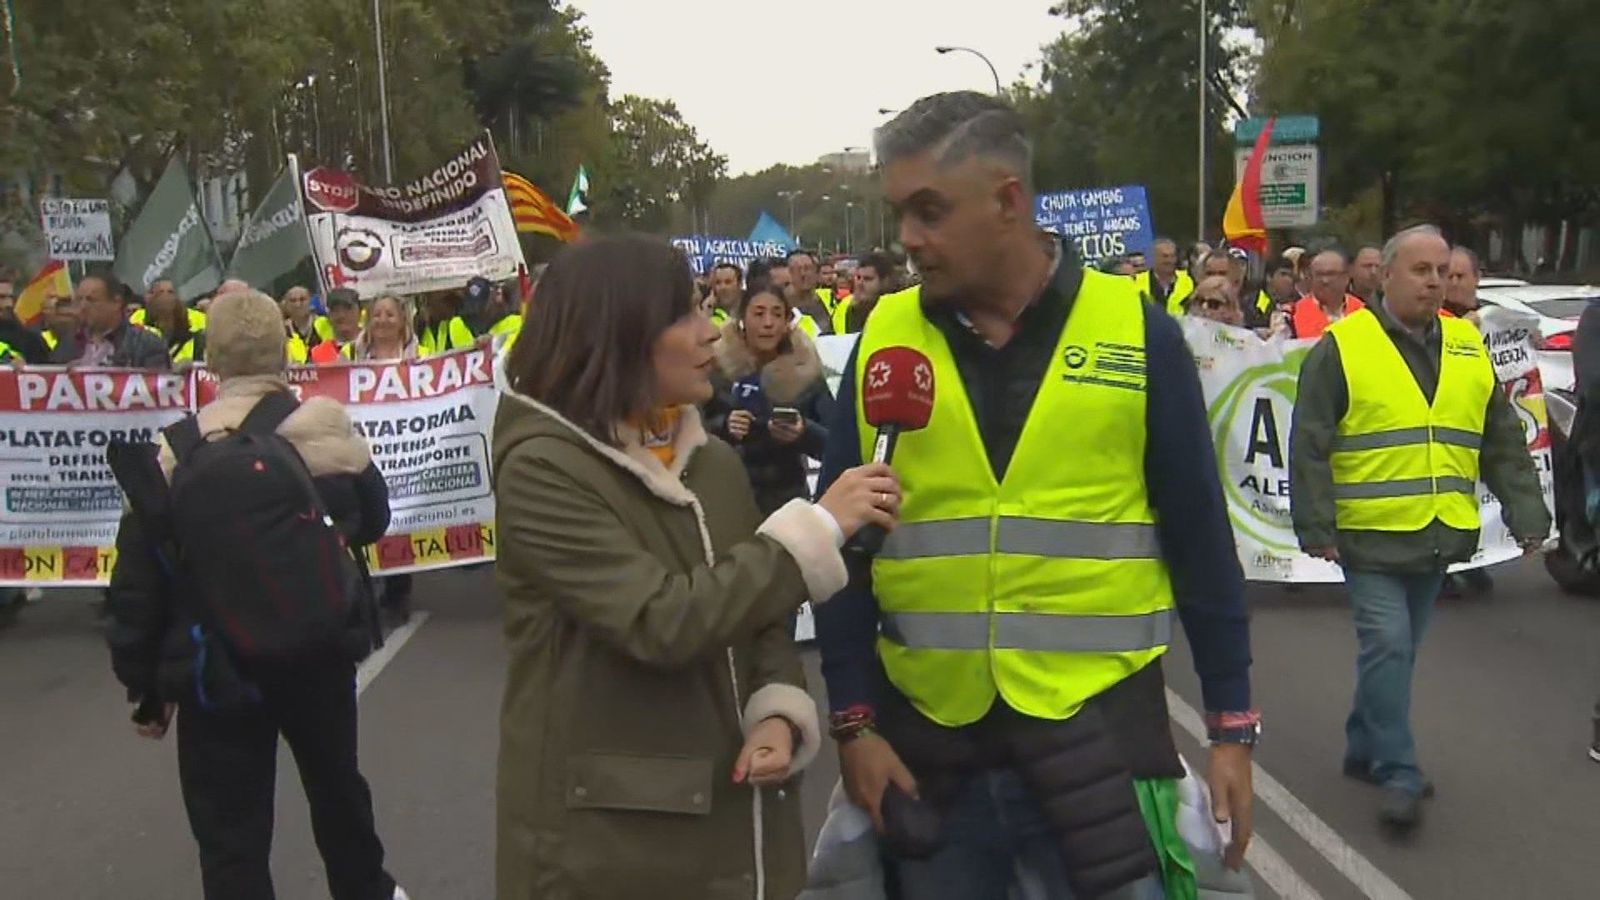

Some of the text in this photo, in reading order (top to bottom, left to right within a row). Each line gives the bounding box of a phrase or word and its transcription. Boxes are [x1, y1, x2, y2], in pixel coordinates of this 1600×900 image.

[406, 141, 488, 196] NACIONAL
[309, 178, 354, 200] STOP
[17, 373, 186, 411] PARAR
[349, 351, 490, 403] PARAR
[372, 437, 436, 456] DEFENSA
[380, 445, 471, 471] TRANSPORTE
